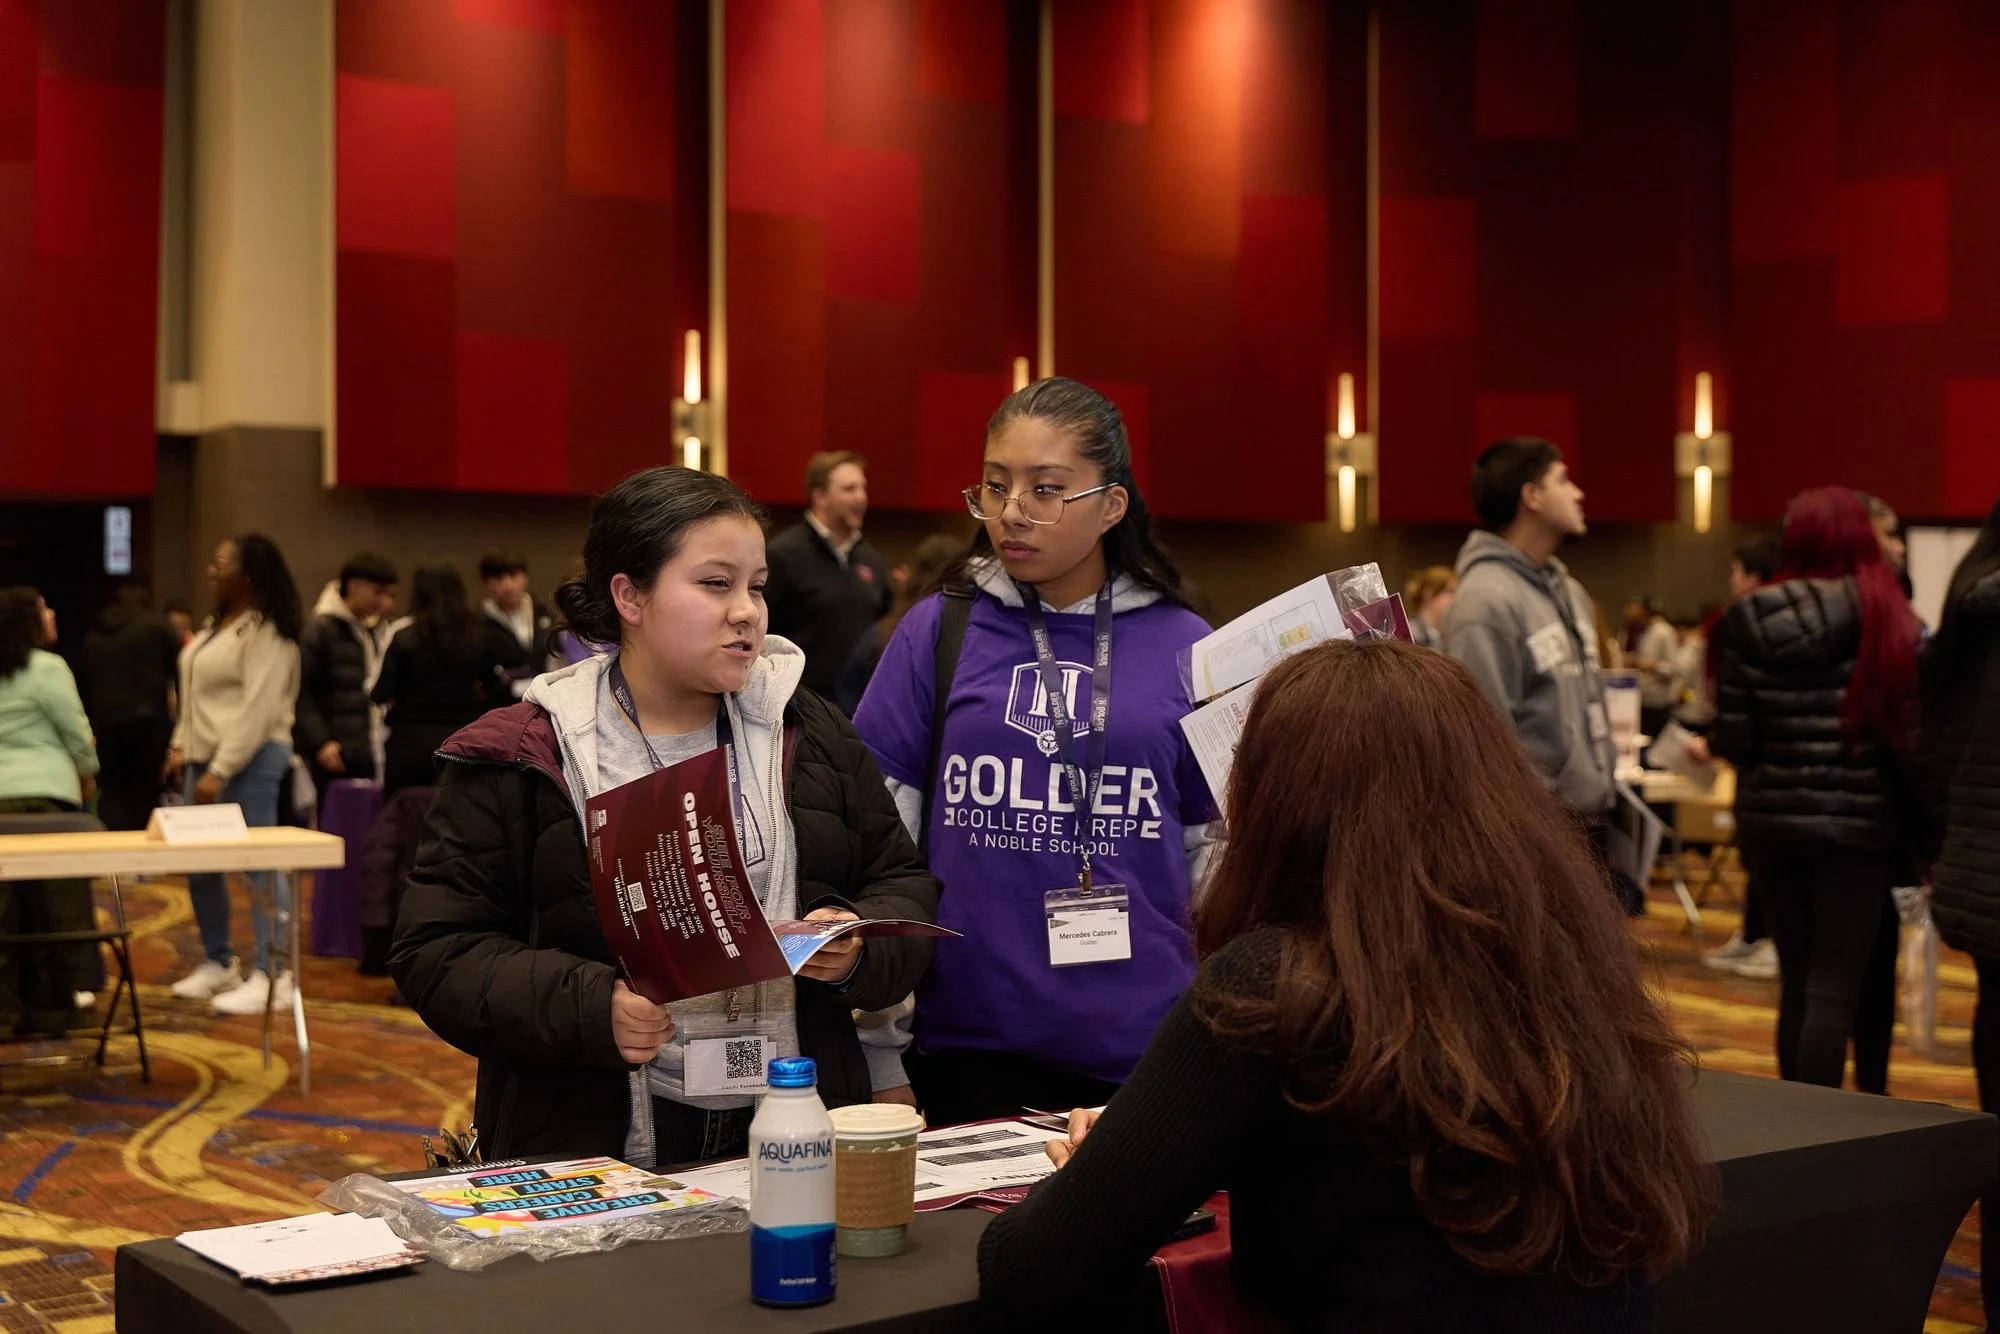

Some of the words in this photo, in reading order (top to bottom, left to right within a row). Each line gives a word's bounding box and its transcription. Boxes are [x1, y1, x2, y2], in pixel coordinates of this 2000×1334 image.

[1050, 692, 1064, 718] GOLDER
[944, 754, 1162, 818] GOLDER
[957, 808, 1064, 835] COLLEGE
[969, 832, 979, 847] A
[985, 834, 1042, 852] NOBLE
[1049, 840, 1119, 856] SCHOOL
[644, 852, 653, 880] Friday,
[650, 880, 659, 899] July
[652, 850, 661, 880] Friday,
[658, 880, 669, 900] April
[657, 833, 667, 871] Monday,
[664, 870, 679, 908] February
[664, 834, 673, 863] Friday,
[670, 863, 686, 906] November
[685, 914, 697, 934] 2025
[672, 830, 683, 868] Monday,
[679, 868, 693, 905] October
[694, 914, 705, 934] 2025
[684, 792, 705, 865] OPEN
[697, 872, 741, 959] HOUSE
[702, 815, 747, 935] YOURSELF
[714, 824, 733, 869] SEE
[726, 875, 752, 920] FOR
[614, 877, 631, 927] visit.siu.edu
[1059, 931, 1091, 940] Mercedes
[1092, 929, 1118, 937] Cabrera
[759, 1139, 832, 1164] AQUAFINA
[481, 1190, 593, 1211] CAREERS
[482, 1171, 543, 1186] HERE
[524, 1177, 596, 1193] START
[544, 1194, 658, 1219] CREATIVE
